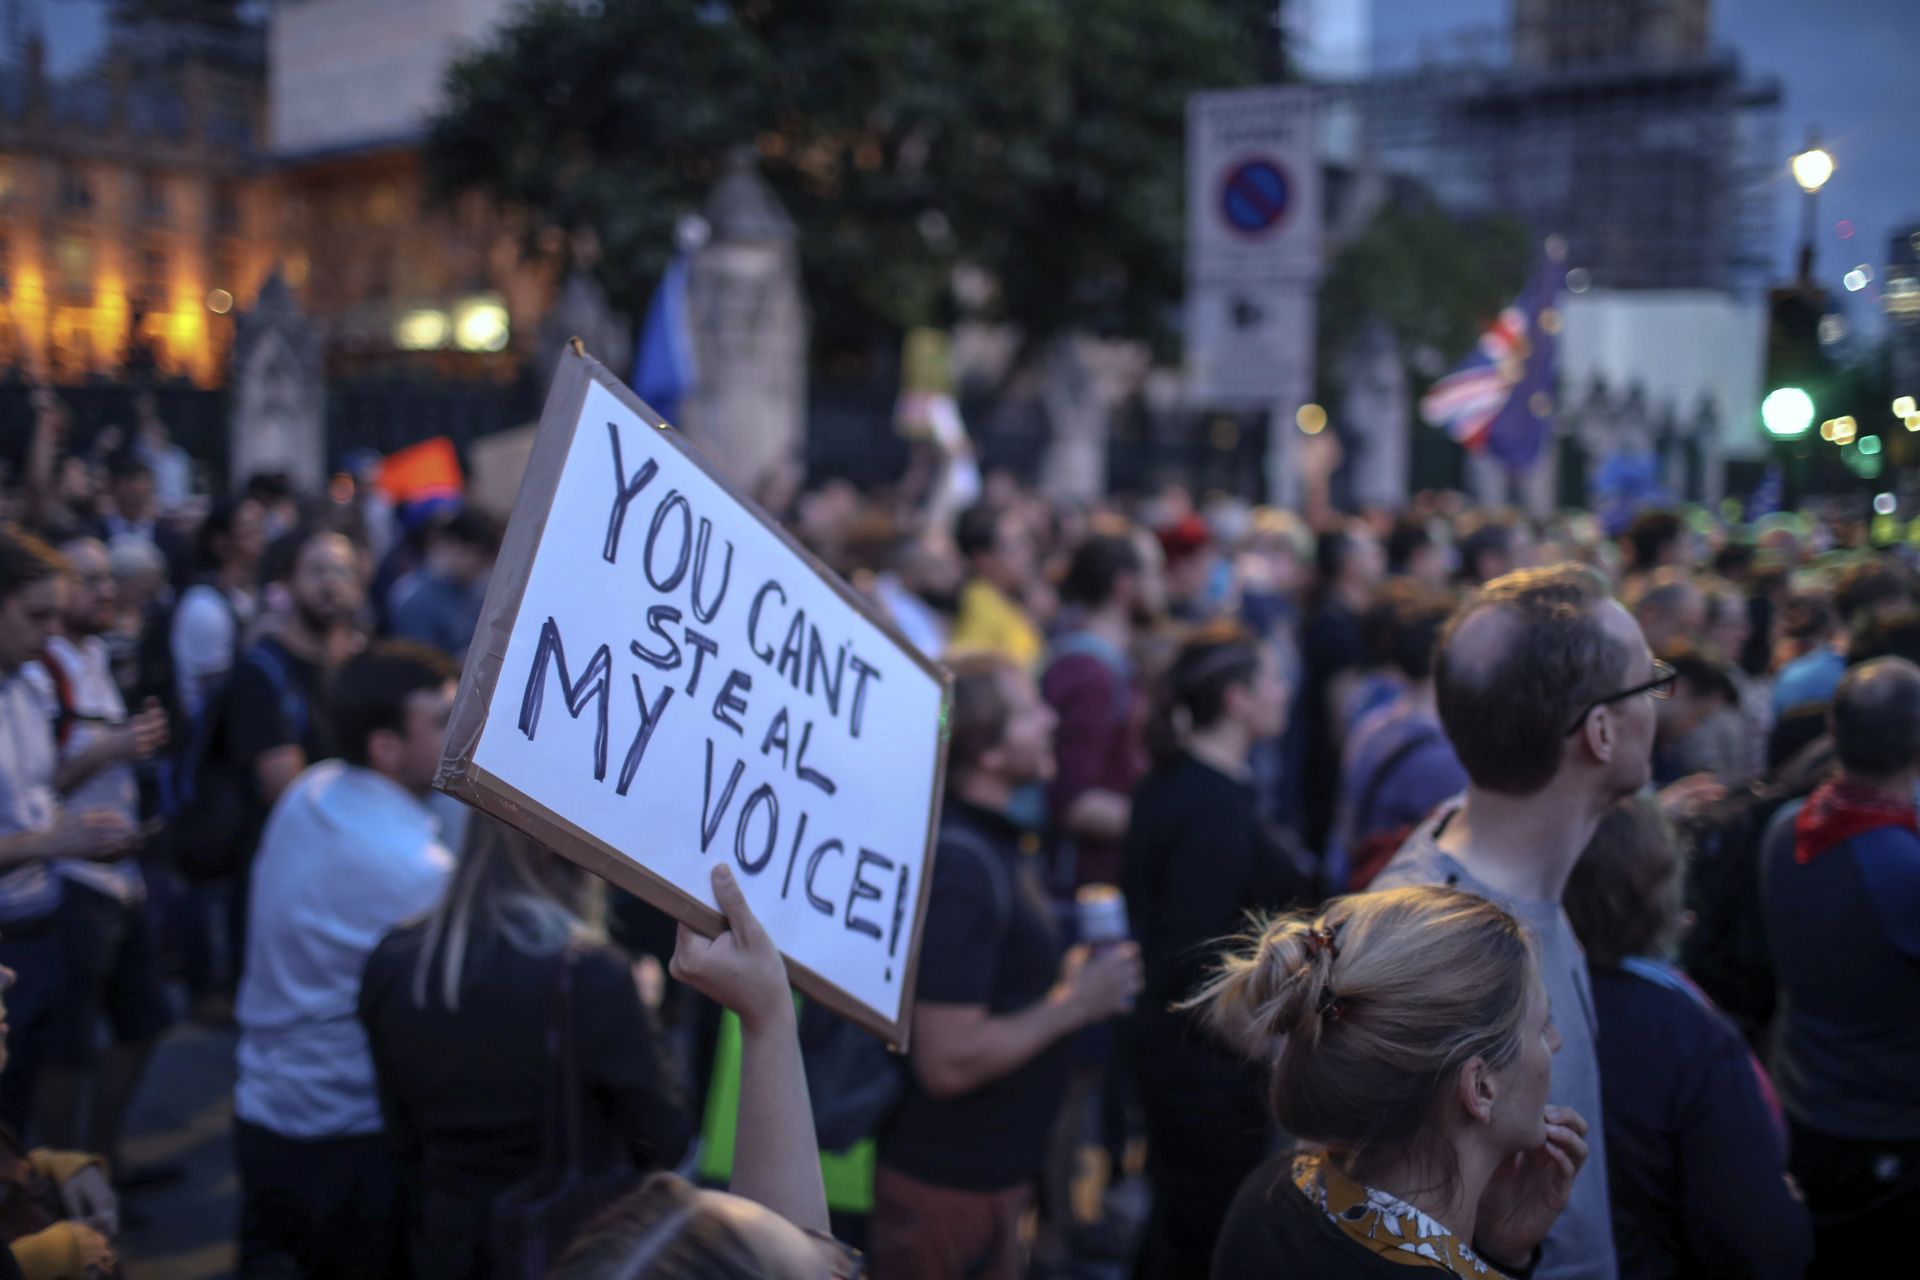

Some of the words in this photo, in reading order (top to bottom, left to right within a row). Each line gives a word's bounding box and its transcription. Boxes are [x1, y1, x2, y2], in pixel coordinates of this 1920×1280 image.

[602, 421, 734, 625] YOU
[517, 615, 676, 797] MY
[700, 737, 909, 983] VOICE!
[629, 604, 837, 797] STEAL
